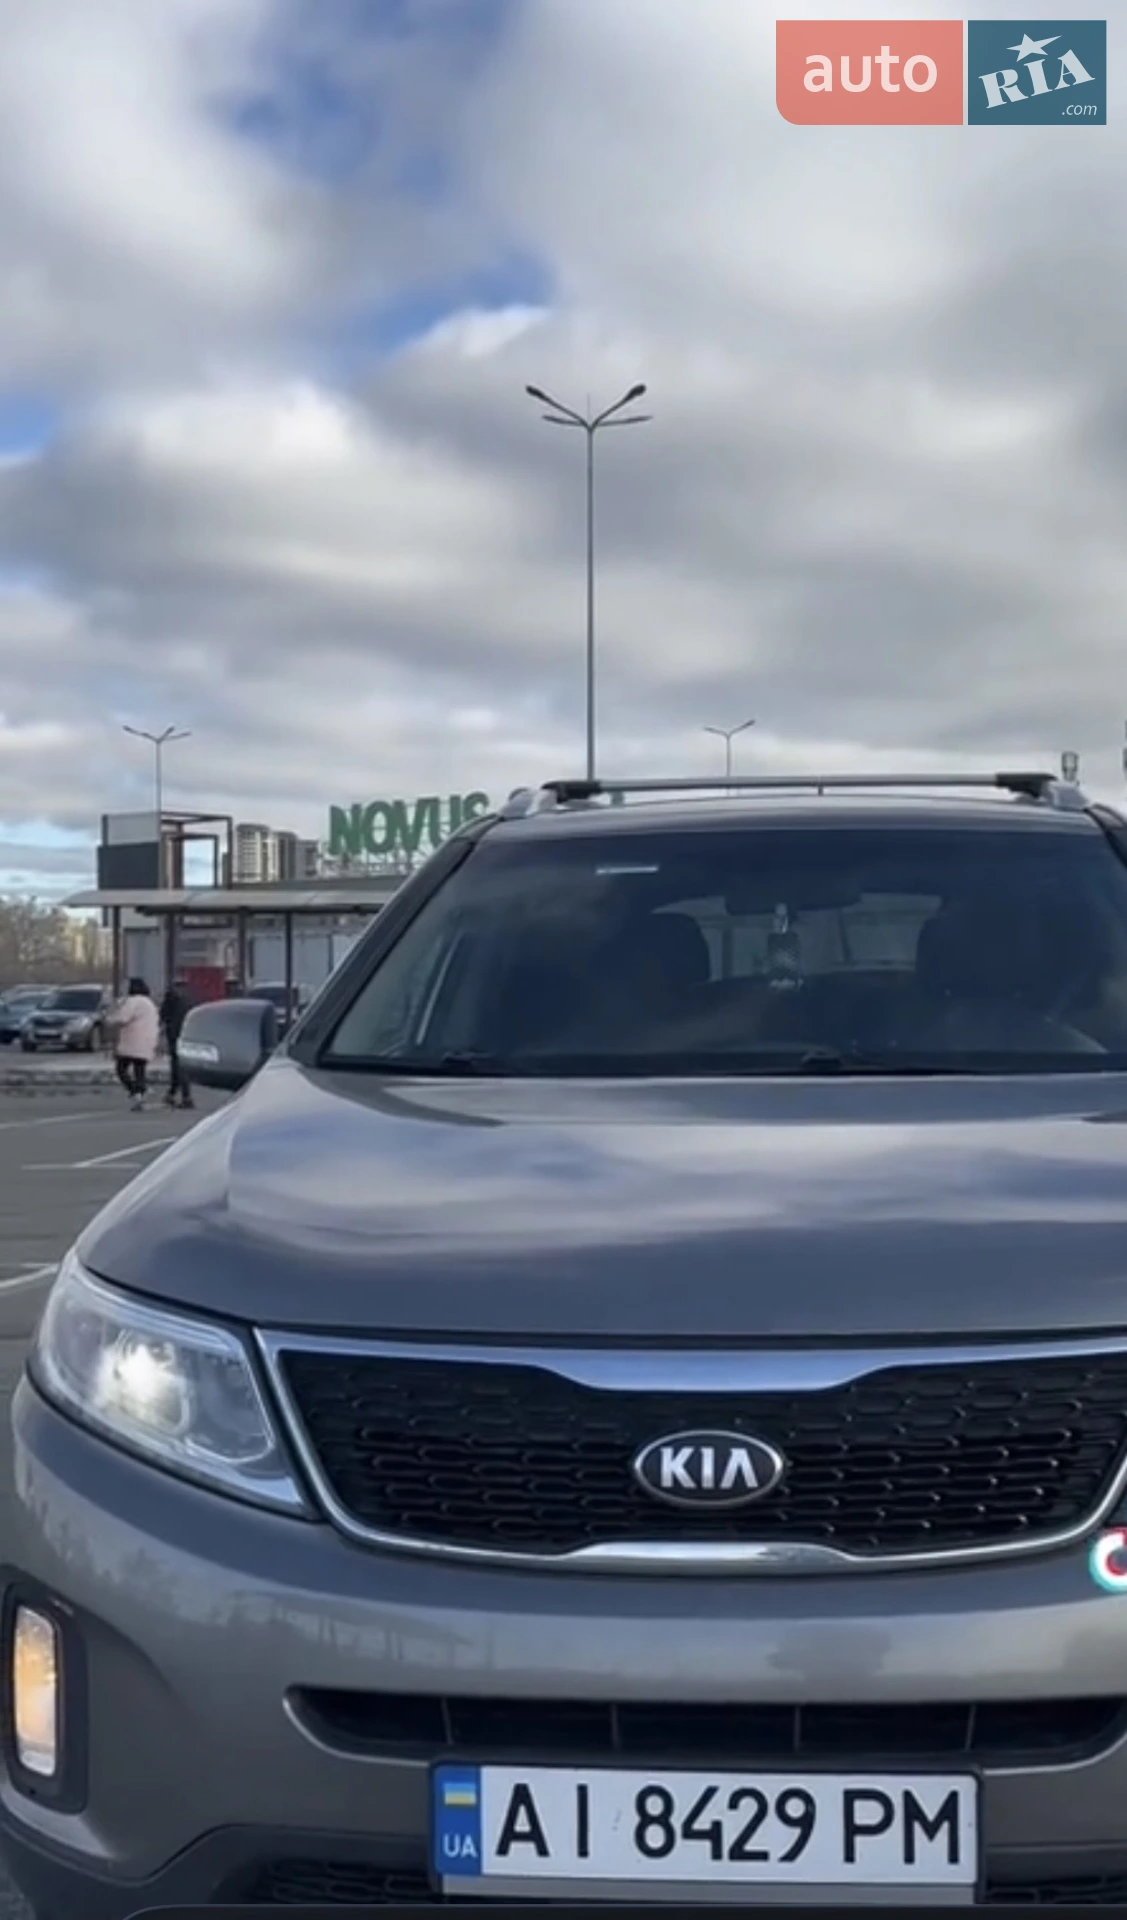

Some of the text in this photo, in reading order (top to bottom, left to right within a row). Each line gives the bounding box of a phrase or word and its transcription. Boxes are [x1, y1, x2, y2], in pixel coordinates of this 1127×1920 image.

[660, 1446, 759, 1489] KIA
[443, 1834, 477, 1858] UA
[634, 1785, 817, 1863] 8429
[843, 1788, 961, 1864] PM
